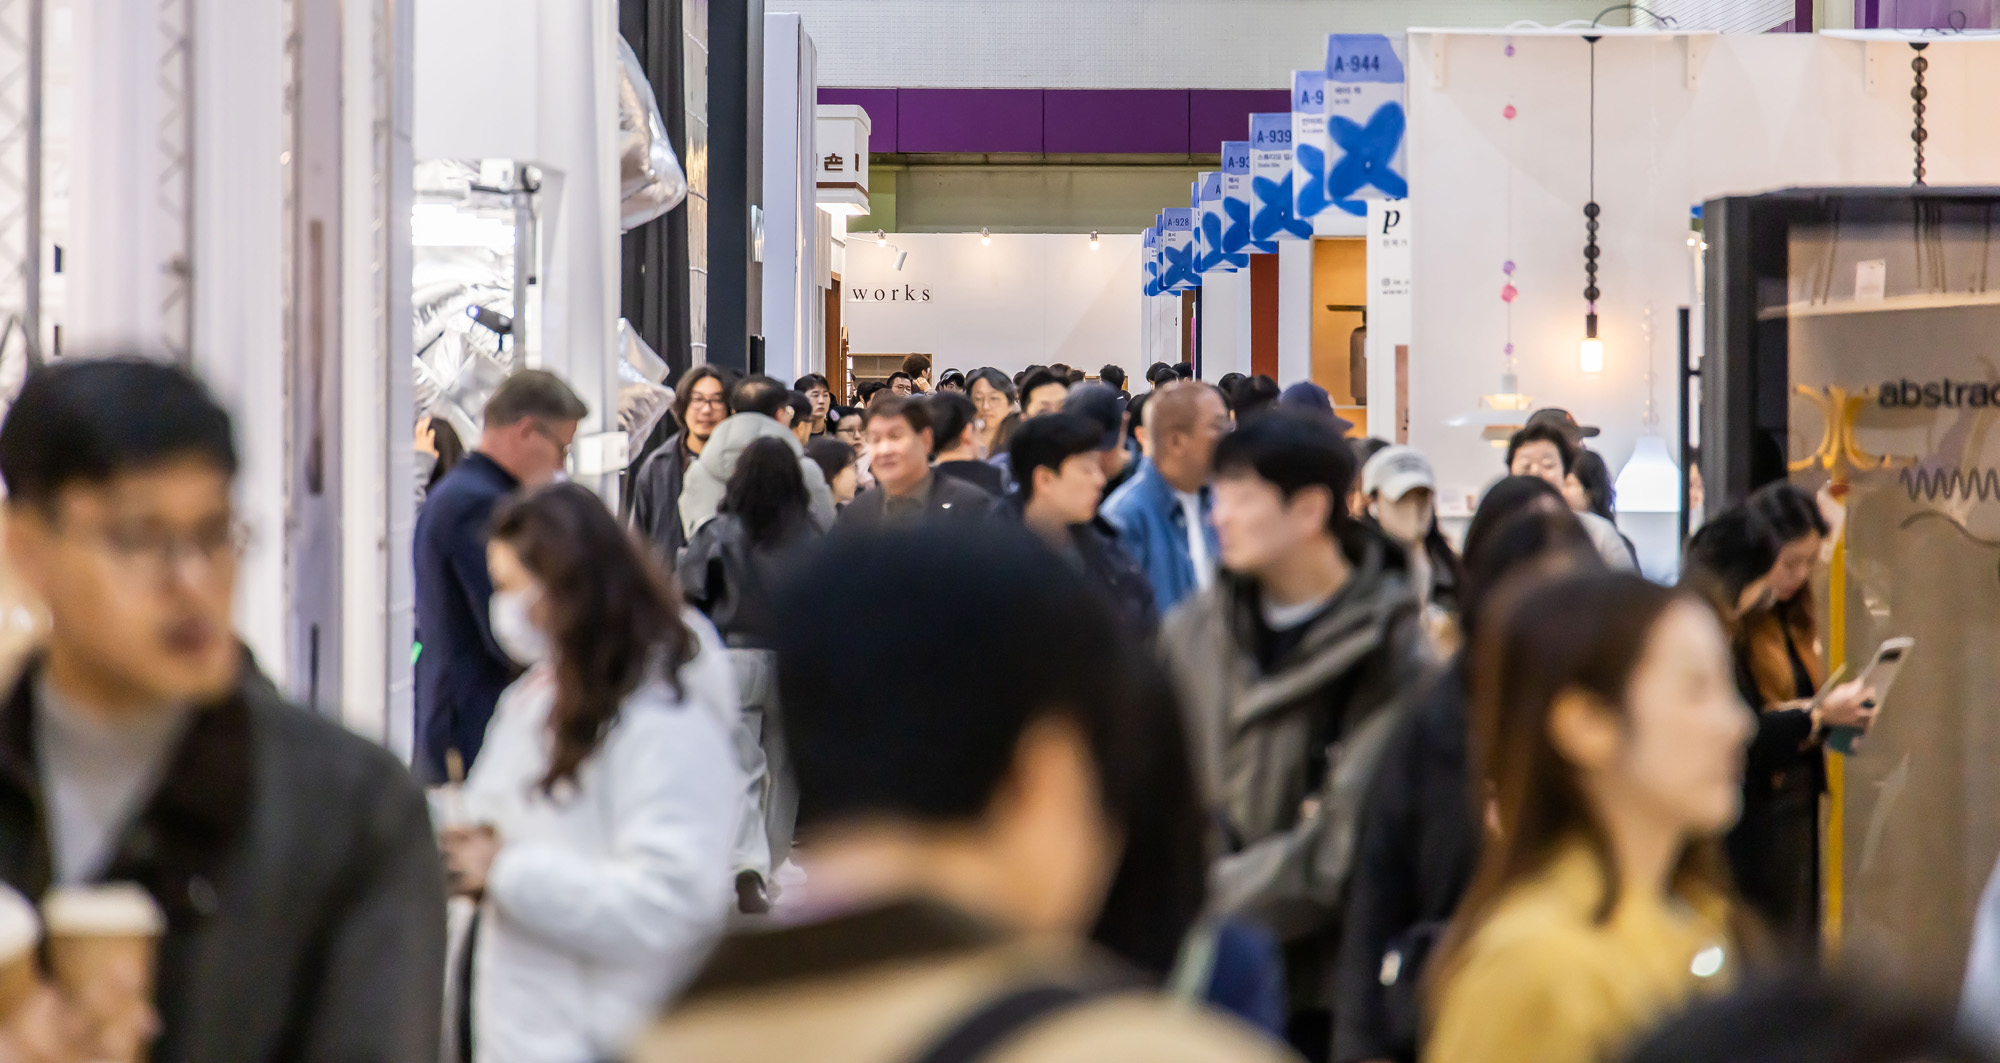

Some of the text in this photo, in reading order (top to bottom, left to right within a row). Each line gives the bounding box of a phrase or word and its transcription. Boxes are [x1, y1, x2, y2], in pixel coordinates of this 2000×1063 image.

[1334, 55, 1379, 73] A-944
[1257, 129, 1292, 143] A-939
[1167, 217, 1189, 226] A-928
[852, 284, 930, 301] works
